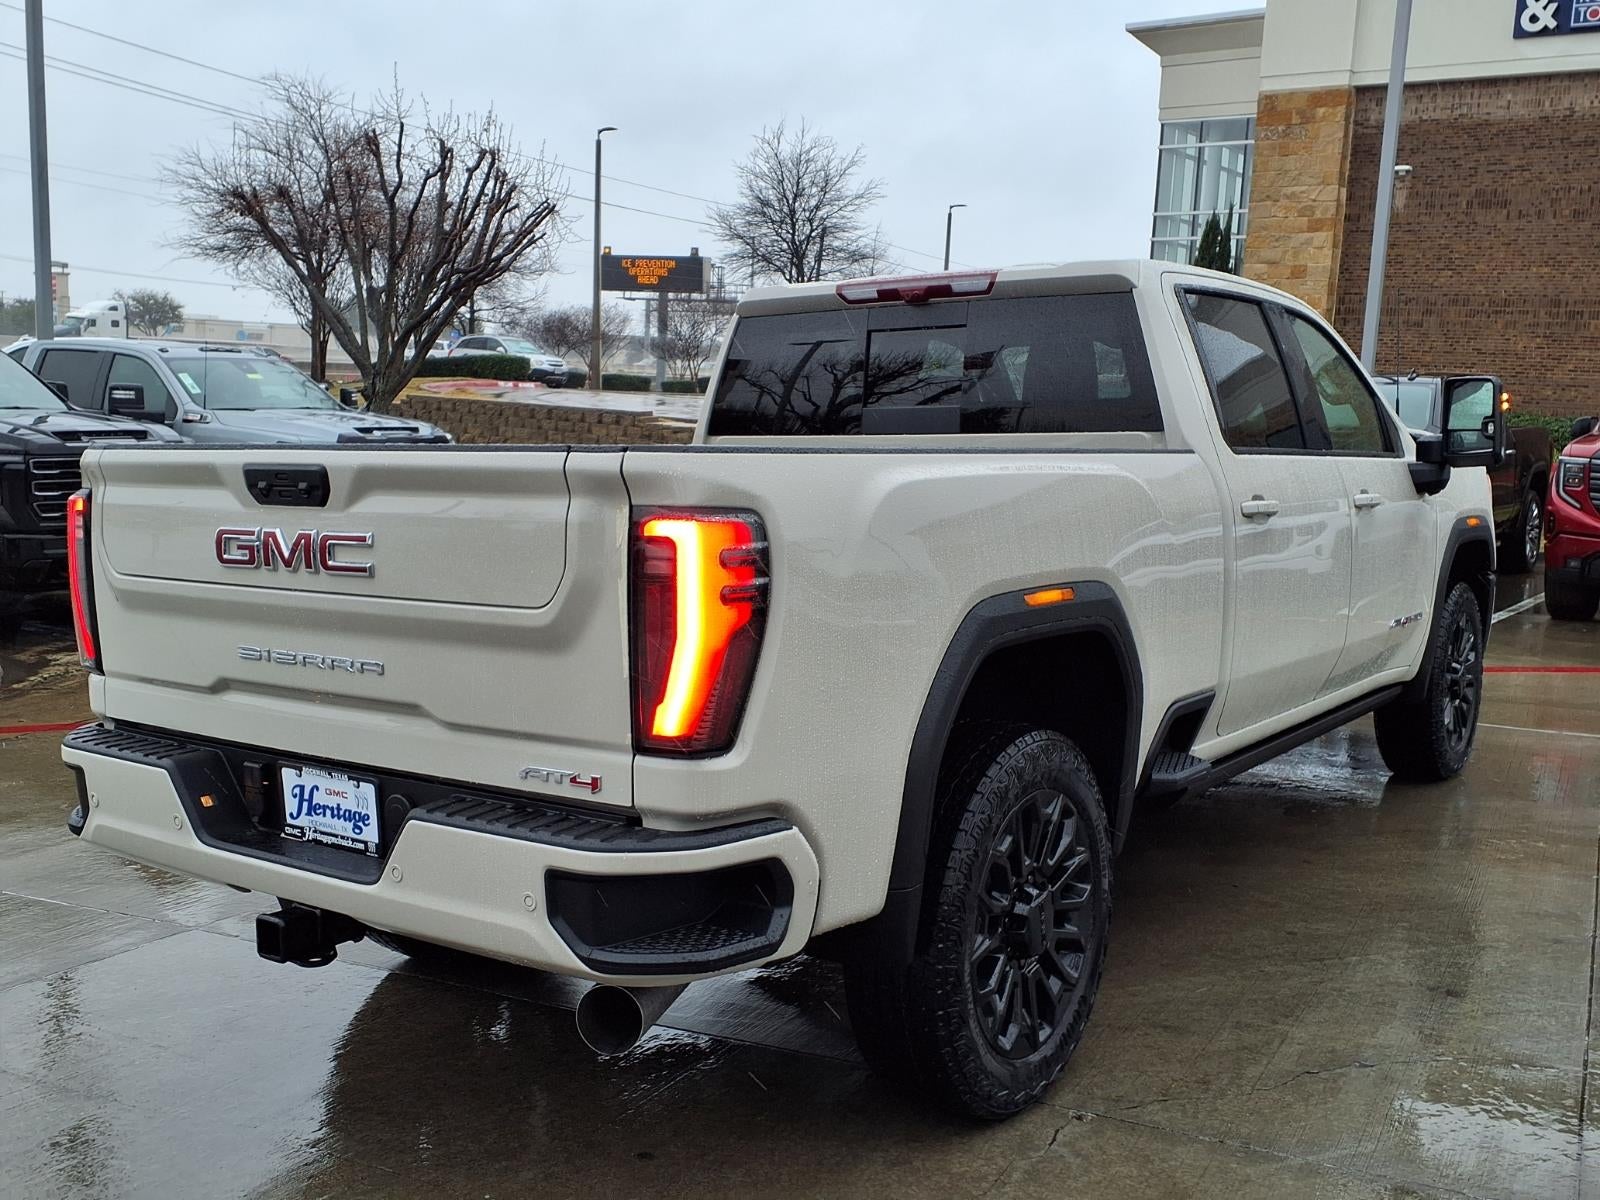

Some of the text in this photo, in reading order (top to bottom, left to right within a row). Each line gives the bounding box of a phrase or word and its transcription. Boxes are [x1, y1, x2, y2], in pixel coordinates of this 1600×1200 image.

[621, 258, 676, 269] ICE PREVENTION
[628, 267, 668, 276] OPERATIONS
[637, 275, 659, 284] AHEAD
[215, 526, 375, 577] GMC
[237, 644, 385, 675] SIERRA
[519, 765, 602, 794] AT4
[324, 787, 348, 799] GMC
[289, 784, 370, 835] Heritage
[284, 826, 302, 836] GMC
